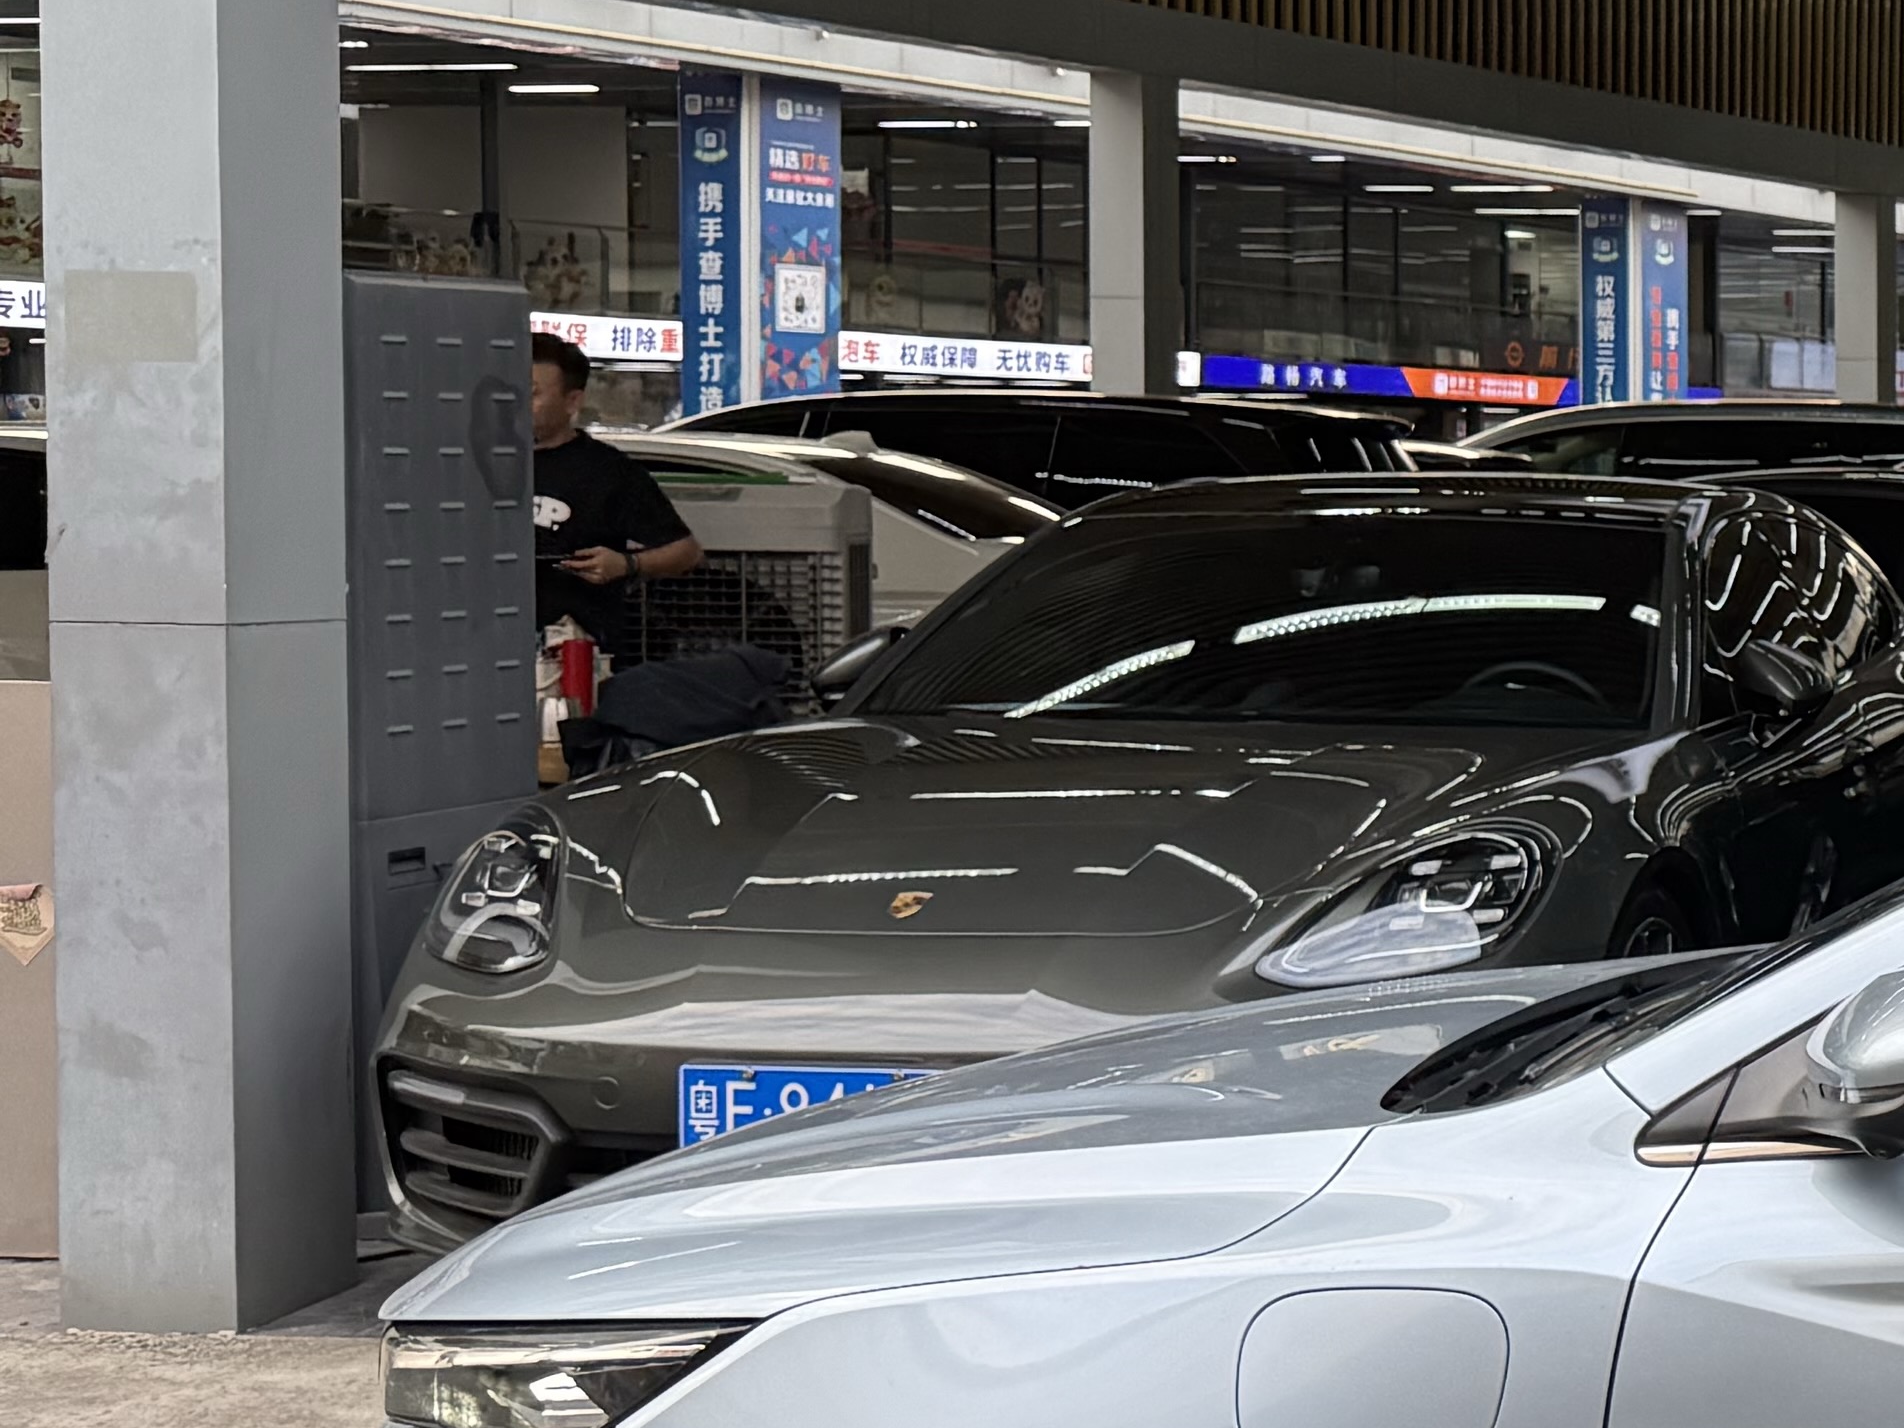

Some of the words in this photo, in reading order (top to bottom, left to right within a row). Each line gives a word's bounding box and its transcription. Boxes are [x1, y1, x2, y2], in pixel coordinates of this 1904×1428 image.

[698, 181, 724, 413] 携手查博士打造
[611, 324, 681, 353] 排除重
[900, 341, 978, 369] 权威保障
[996, 348, 1072, 375] 无忧购车
